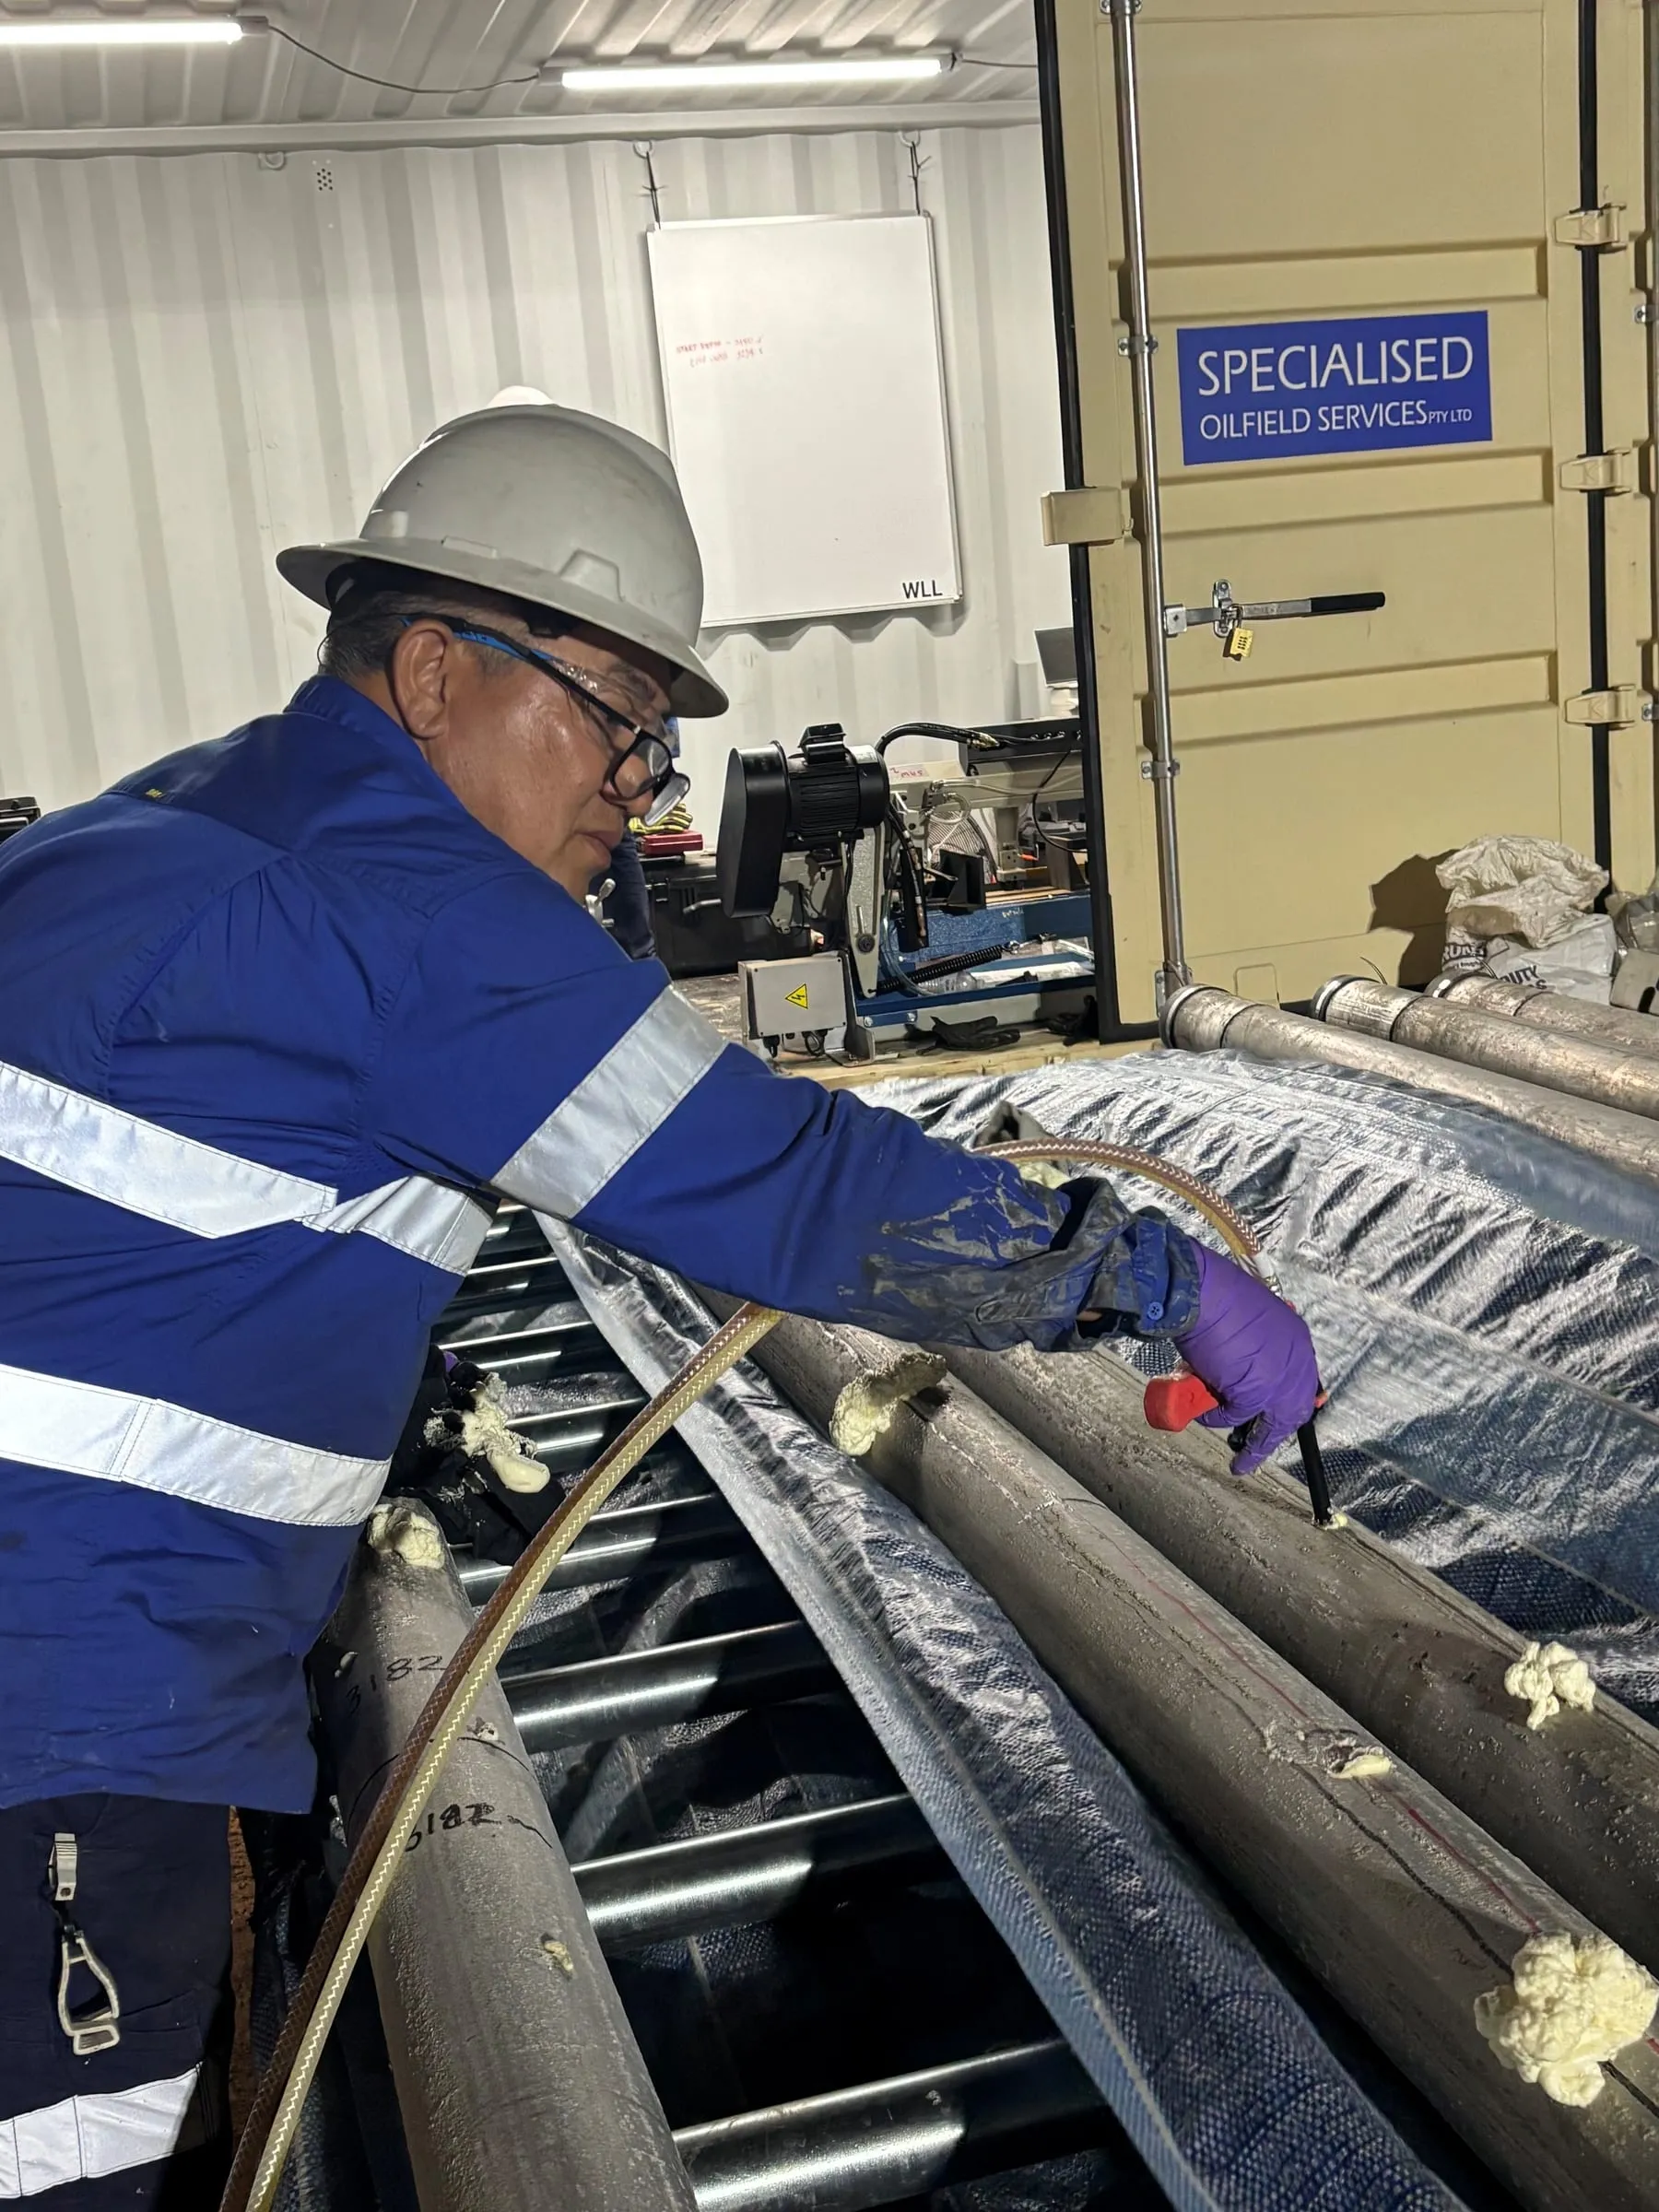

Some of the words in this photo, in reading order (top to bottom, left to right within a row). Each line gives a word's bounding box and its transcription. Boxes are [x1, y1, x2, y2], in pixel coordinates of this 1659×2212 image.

[1198, 336, 1474, 396] SPECIALISED
[1200, 408, 1312, 440] OILFIELD
[1318, 400, 1428, 431] SERVICES
[1429, 411, 1449, 424] PTY
[1451, 408, 1473, 423] LTD
[902, 580, 944, 599] WLL
